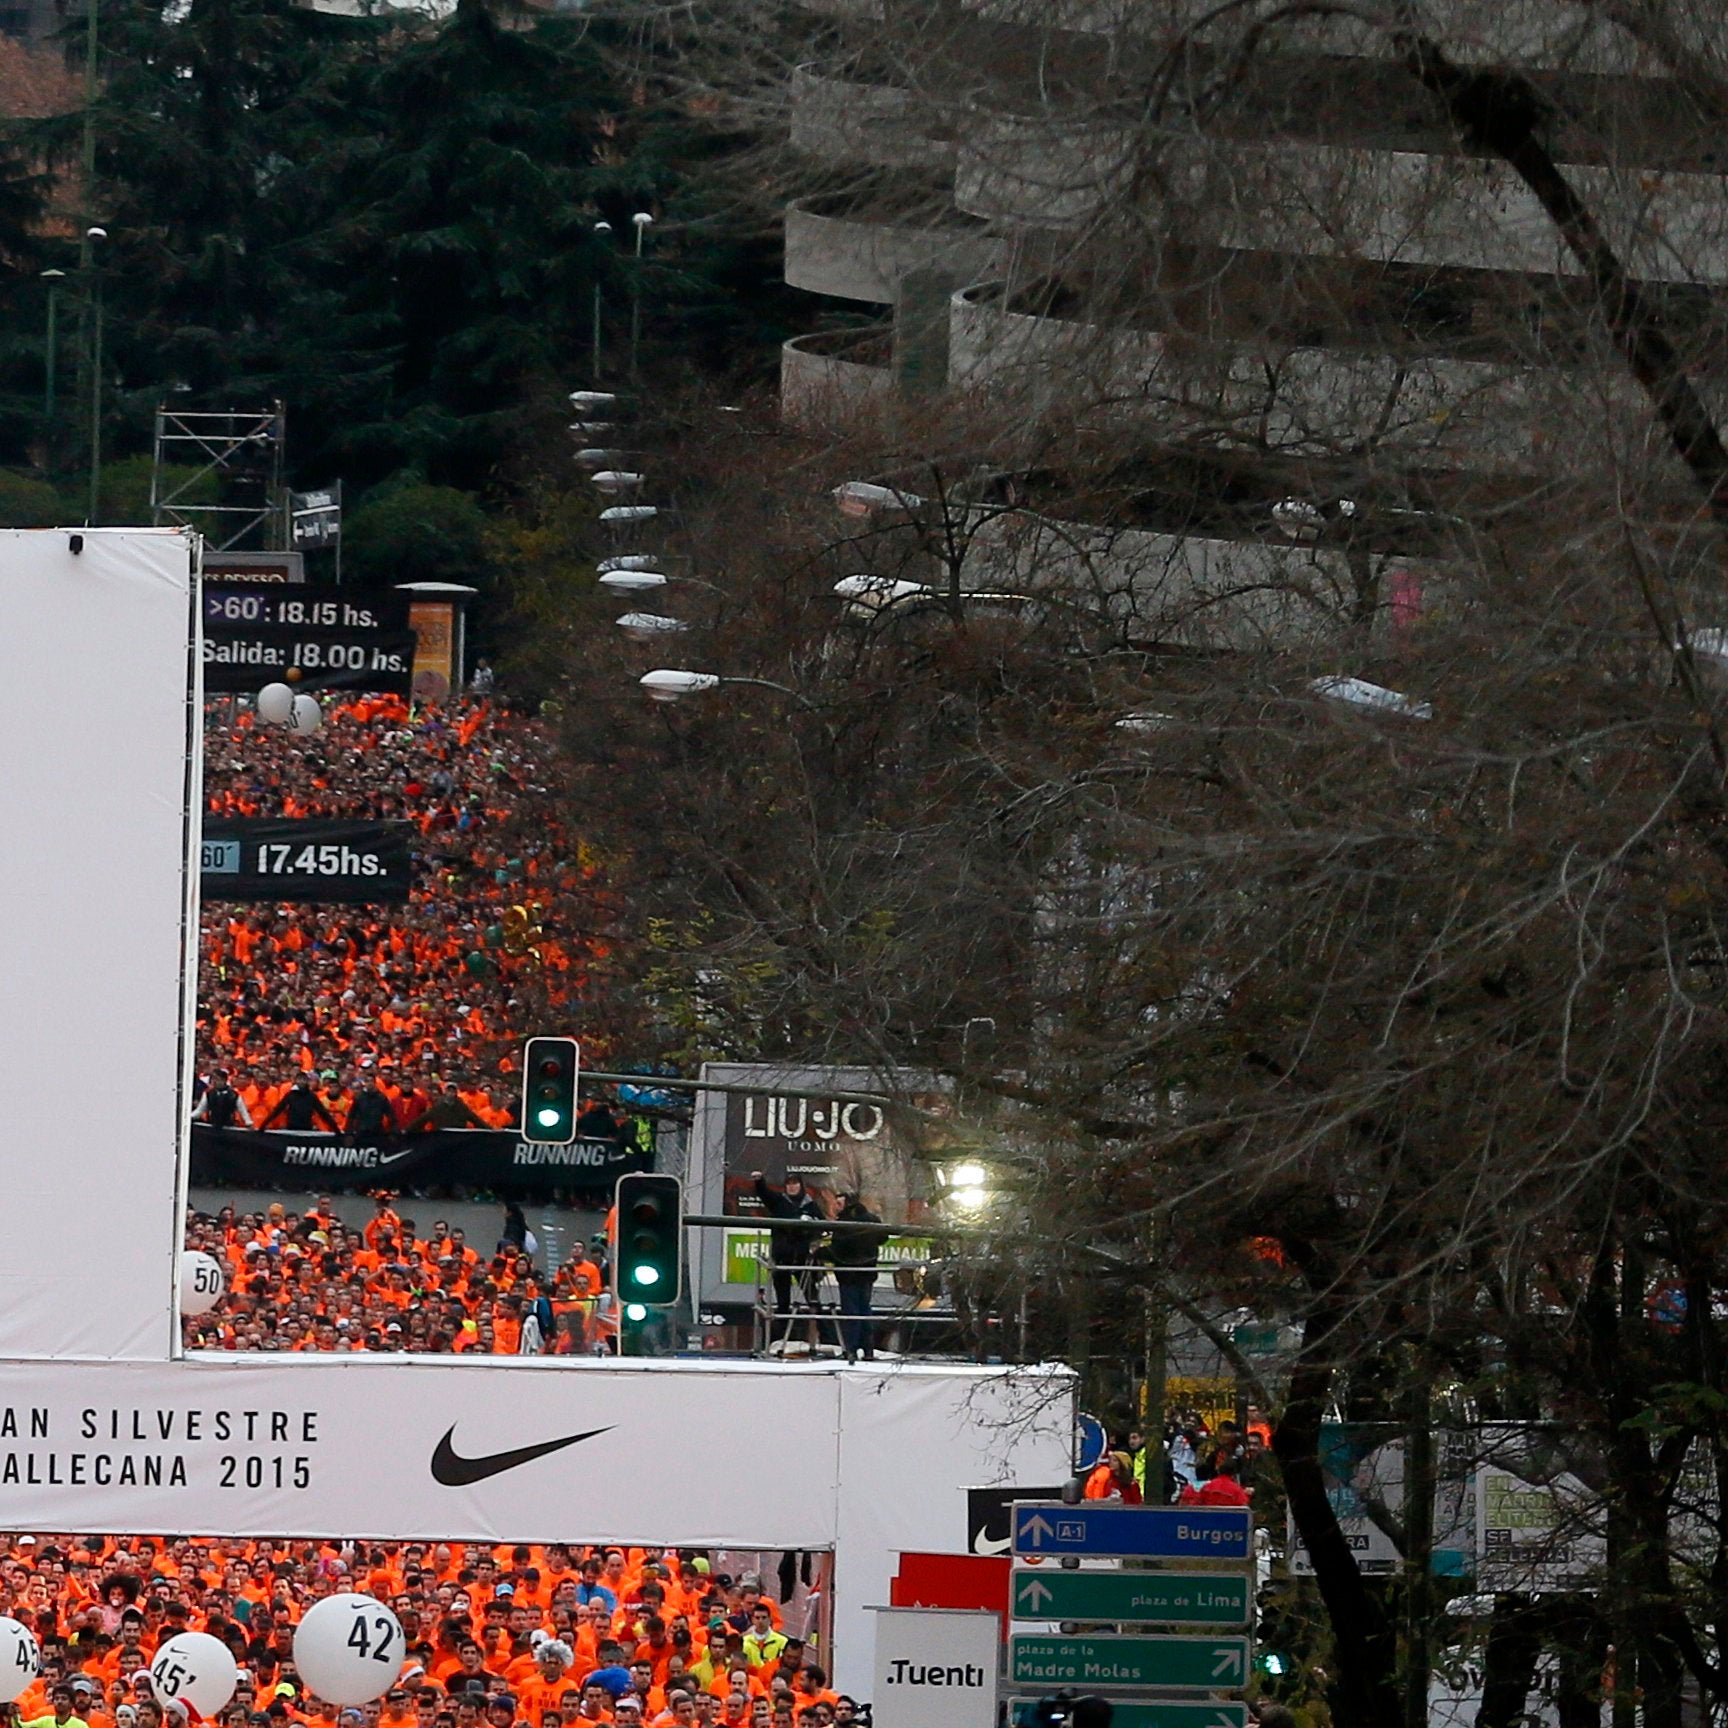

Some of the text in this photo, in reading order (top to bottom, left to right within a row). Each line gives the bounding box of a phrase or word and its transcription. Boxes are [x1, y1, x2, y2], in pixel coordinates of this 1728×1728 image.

[278, 601, 338, 625] 18.15
[344, 603, 379, 628] hs.
[203, 639, 408, 673] Salida: 18.00 hs.
[283, 1146, 378, 1168] RUNNING
[513, 1144, 605, 1166] RUNNING
[787, 1141, 841, 1152] UOMO
[82, 1409, 319, 1443] SILVESTRE
[220, 1455, 311, 1490] 2015
[1061, 1525, 1244, 1544] A-1 Burgos
[1131, 1592, 1242, 1607] plaza de Lima
[1017, 1644, 1094, 1656] plaza de la
[1017, 1661, 1141, 1679] Madre Molas
